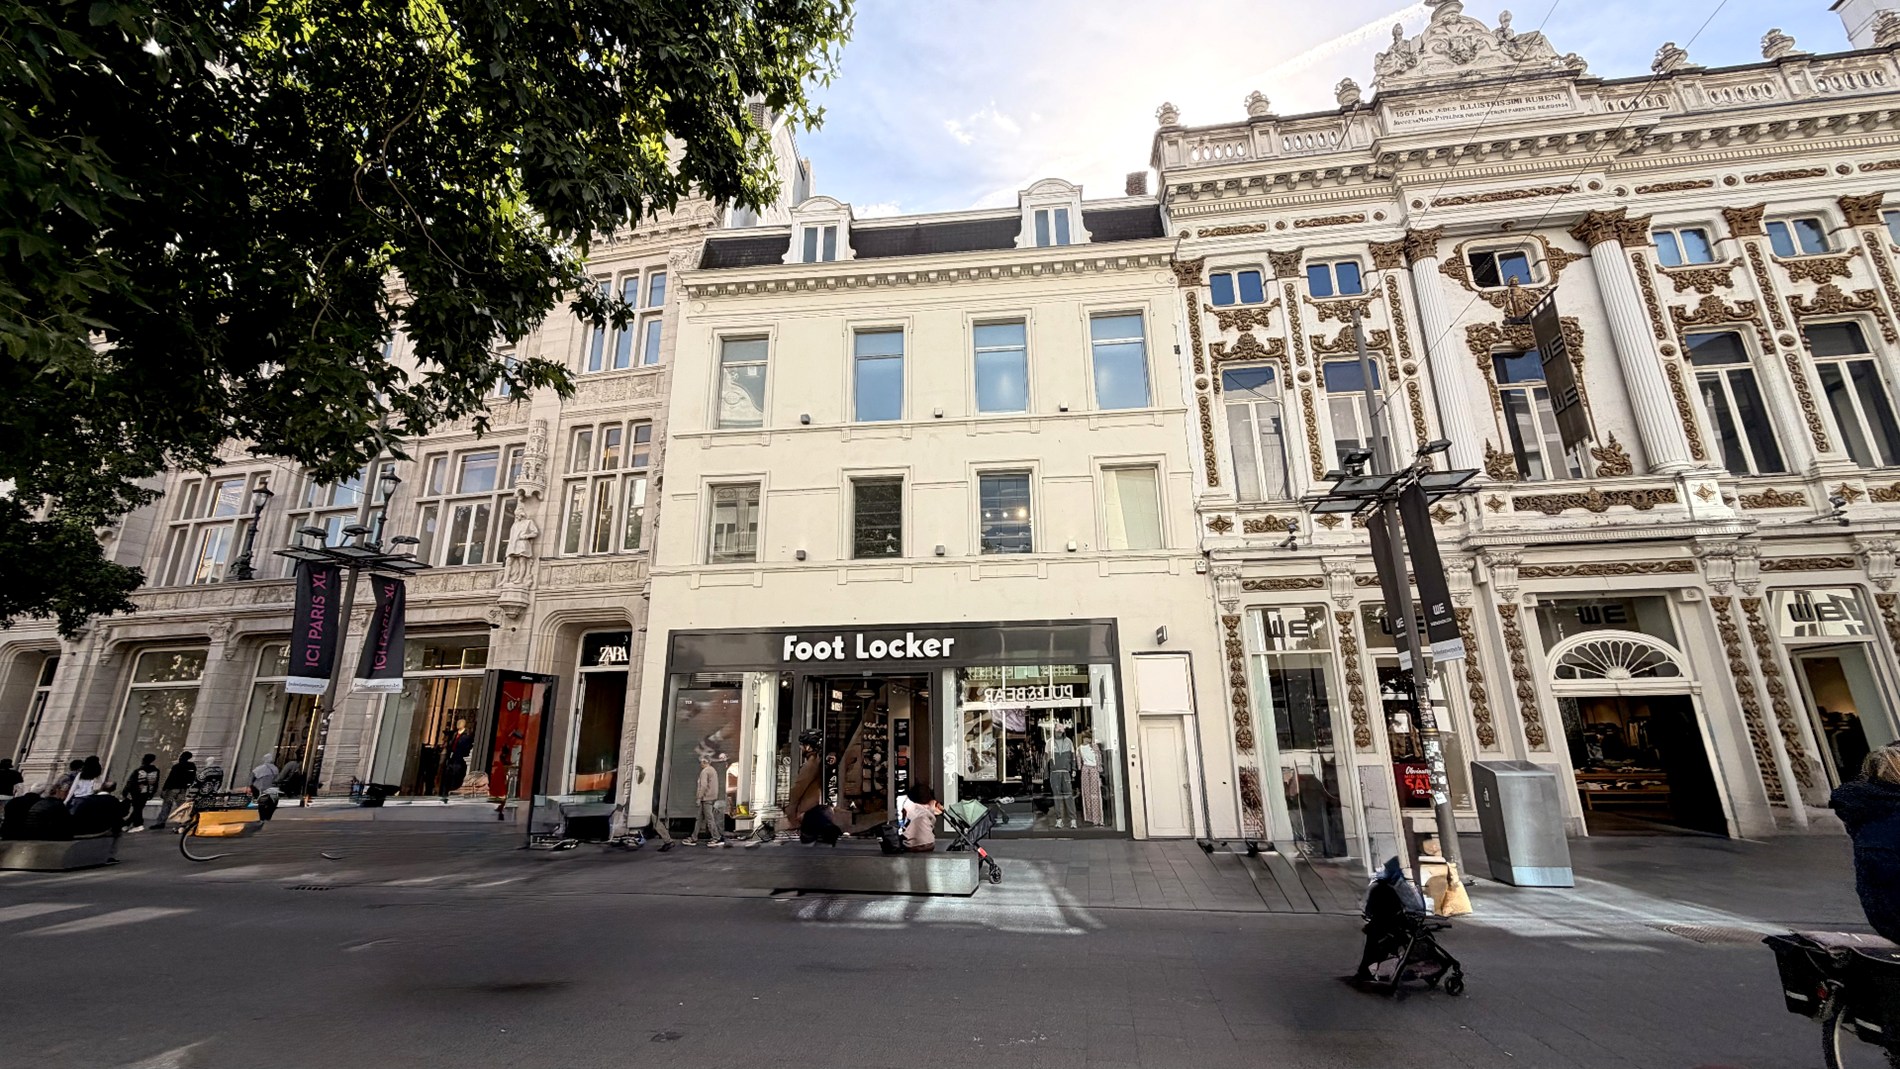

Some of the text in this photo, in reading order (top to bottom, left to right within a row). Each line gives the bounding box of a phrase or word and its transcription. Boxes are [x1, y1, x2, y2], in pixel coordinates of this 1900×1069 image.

[1525, 93, 1561, 104] RUBENI
[1540, 333, 1565, 366] WE
[1553, 384, 1579, 416] WE
[312, 571, 327, 590] XL
[308, 595, 326, 640] PARIS
[1432, 602, 1446, 616] WE
[1577, 604, 1628, 625] WE
[1787, 603, 1850, 622] WE
[374, 651, 387, 670] ICI
[384, 583, 395, 599] XL
[1265, 619, 1309, 639] WE
[304, 645, 321, 668] ICI
[598, 646, 629, 662] ZARA
[783, 632, 955, 662] Foot Locker
